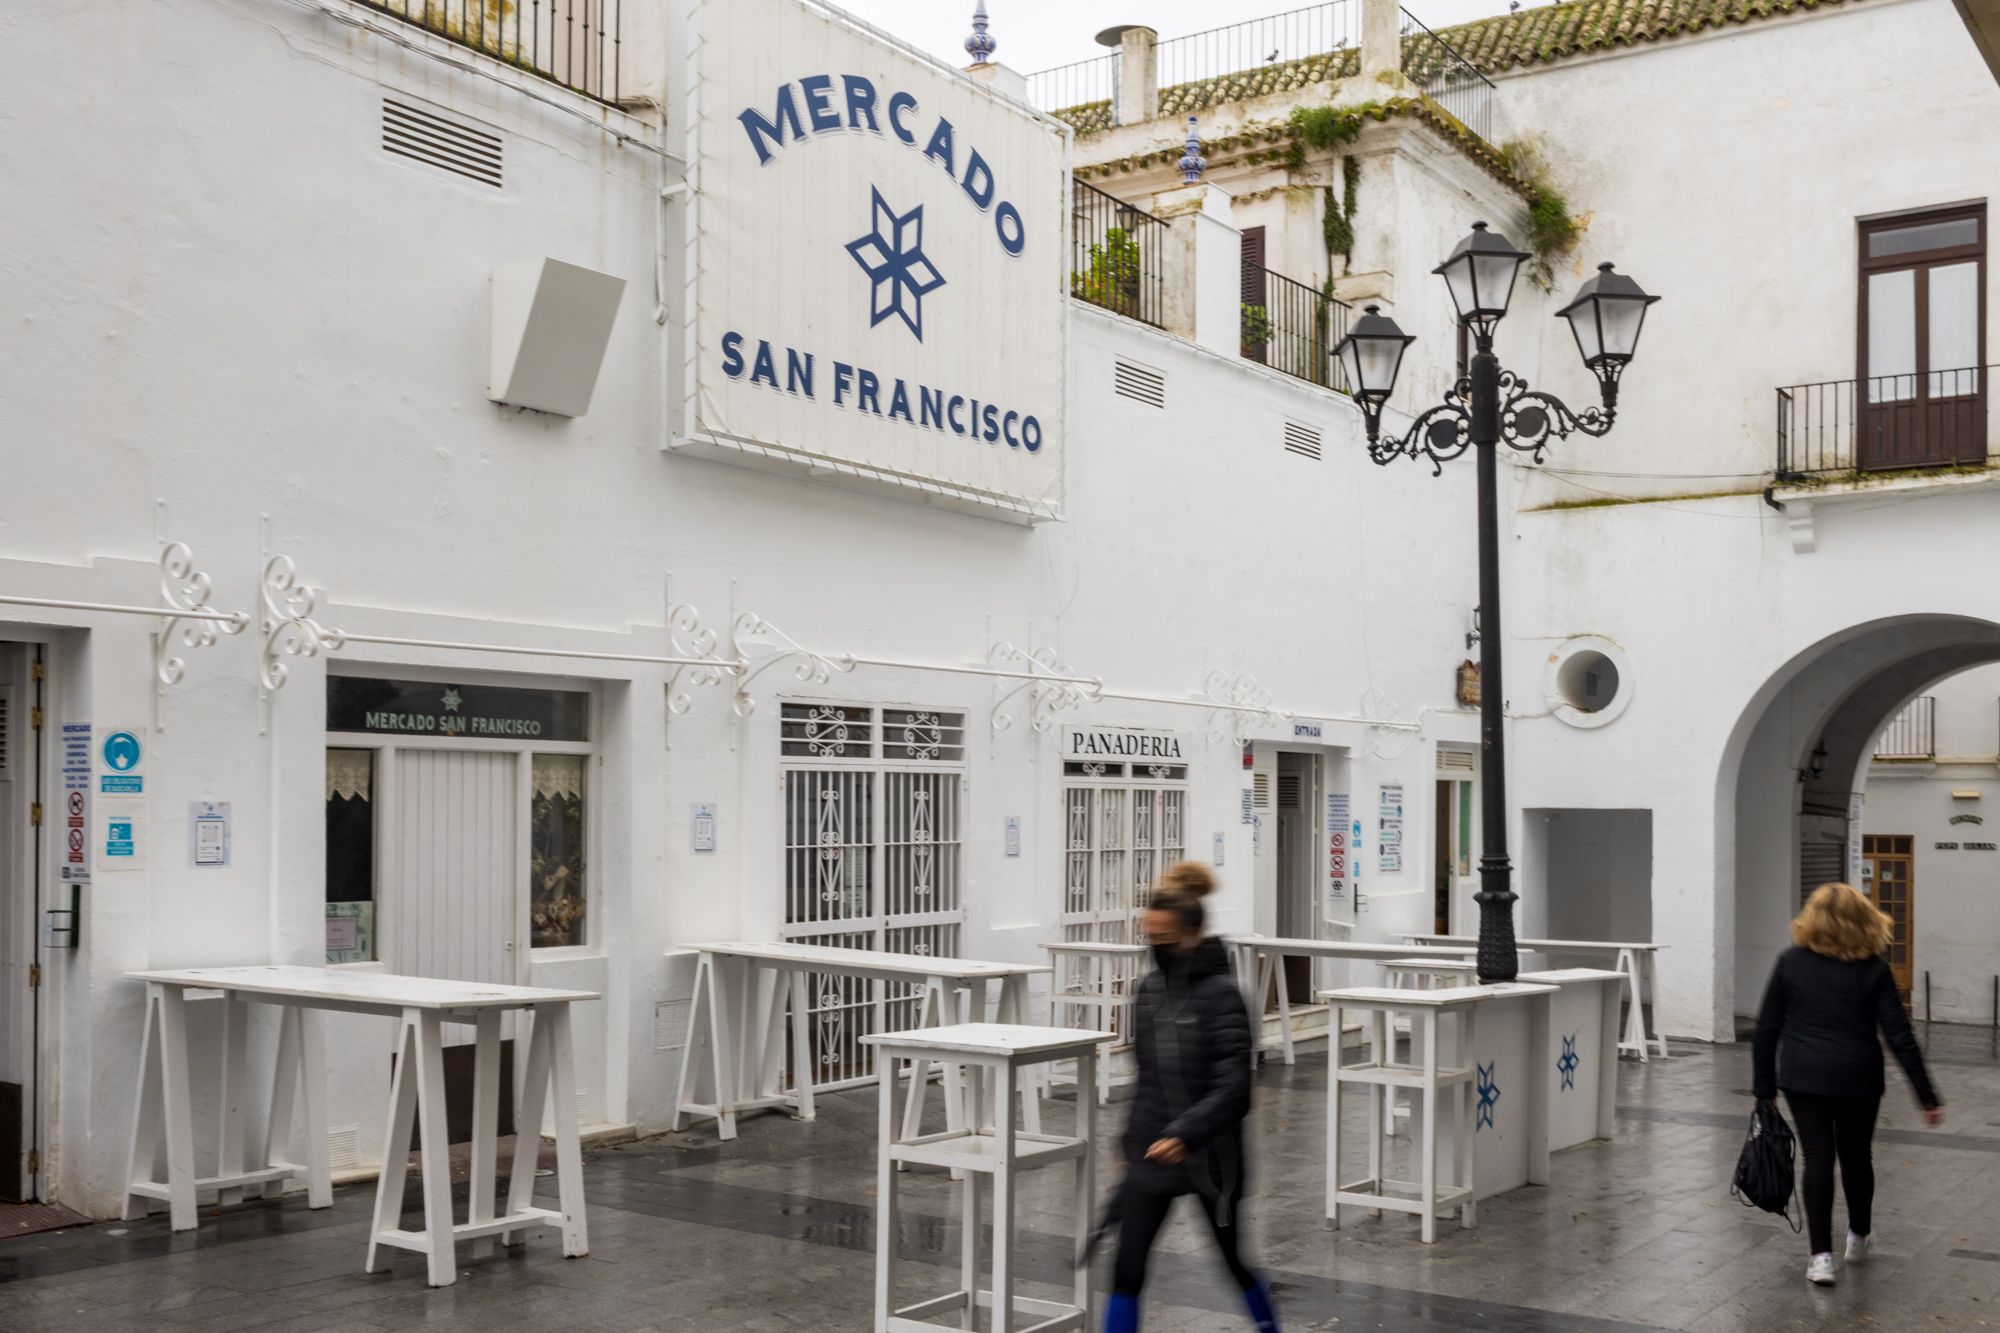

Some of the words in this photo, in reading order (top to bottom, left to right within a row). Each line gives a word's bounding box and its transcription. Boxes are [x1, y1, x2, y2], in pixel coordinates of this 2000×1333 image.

[737, 73, 1026, 258] MERCADO
[721, 331, 815, 399] SAN
[832, 360, 1043, 453] FRANCISCO
[365, 711, 435, 731] MERCADO
[439, 715, 467, 733] SAN
[471, 717, 542, 736] FRANCISCO
[1071, 732, 1182, 758] PANADERIA
